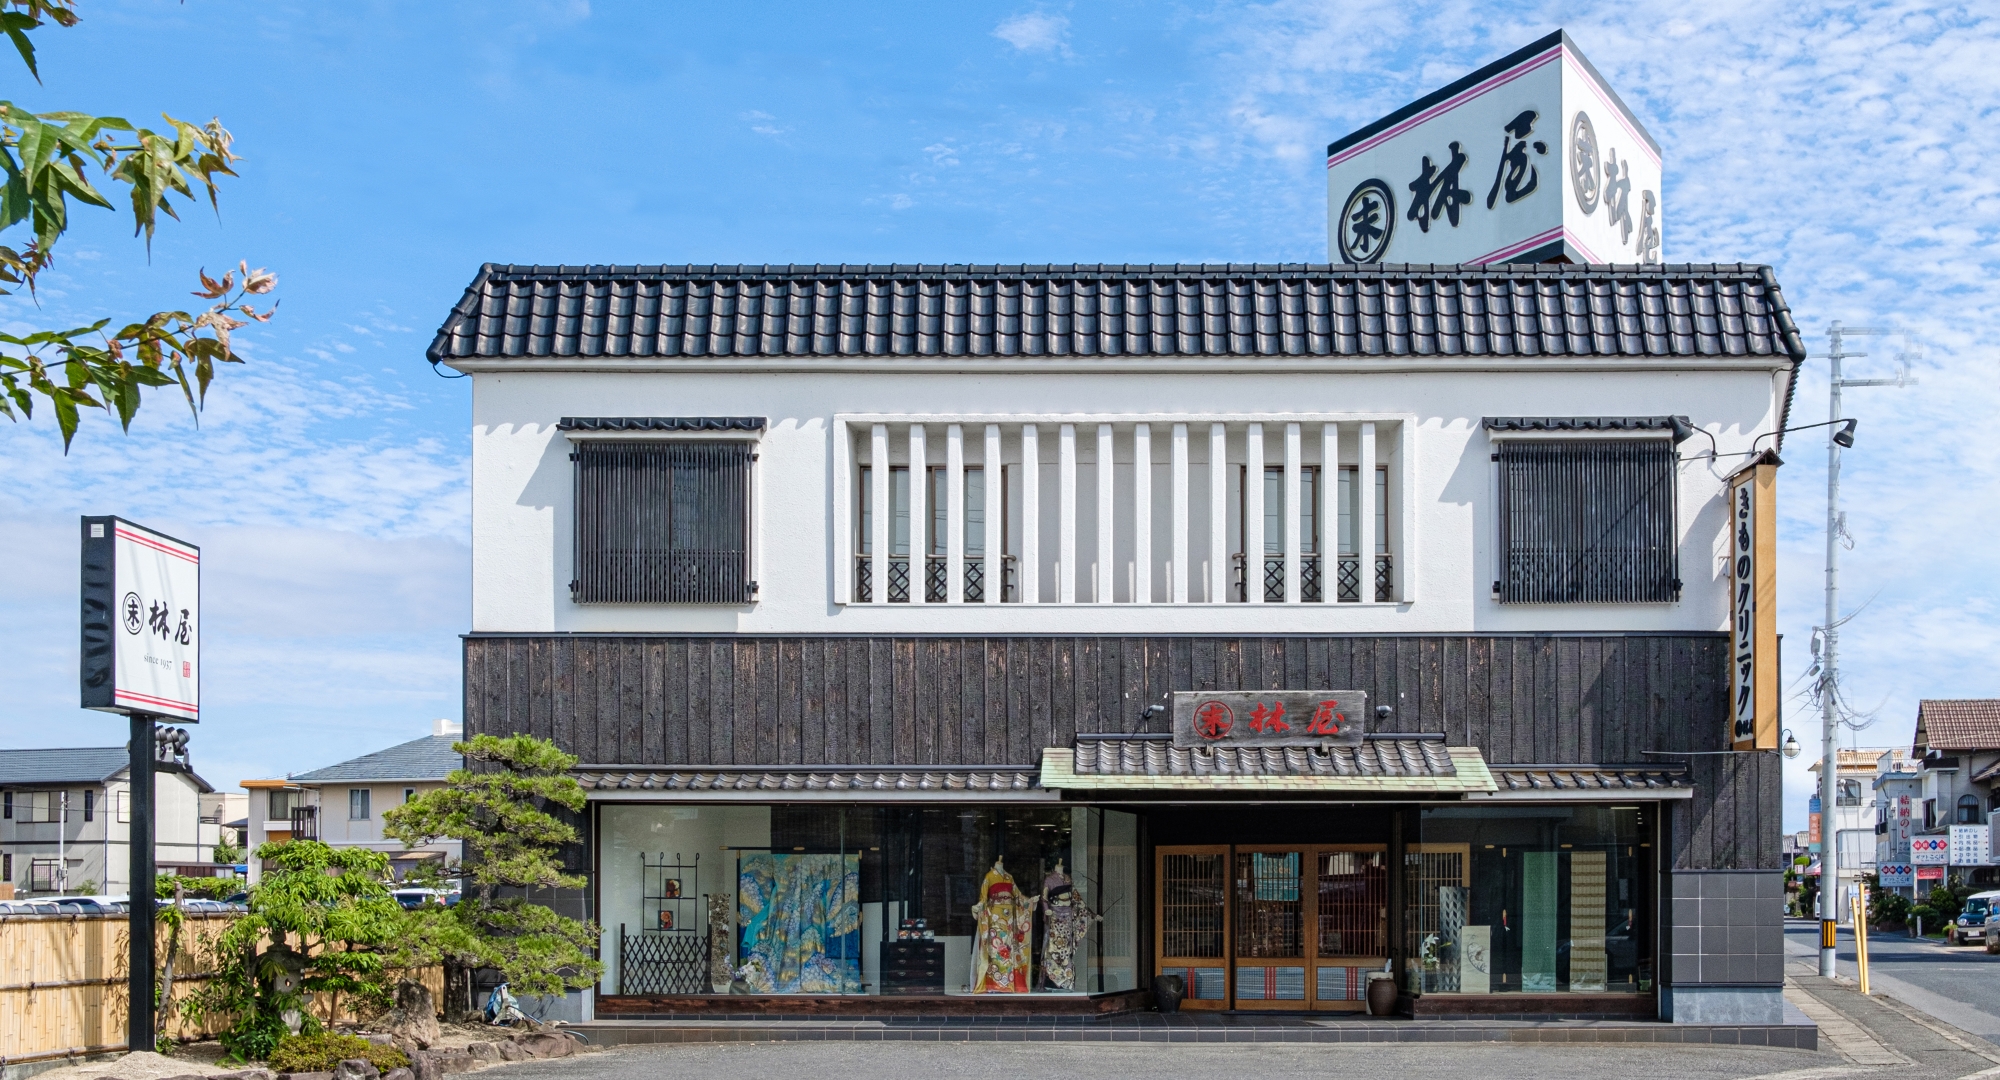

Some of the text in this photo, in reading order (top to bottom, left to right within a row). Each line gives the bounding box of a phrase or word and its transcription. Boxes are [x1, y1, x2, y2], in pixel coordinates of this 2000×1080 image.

[1407, 110, 1548, 233] 林屋
[148, 598, 193, 646] 林屋
[1736, 487, 1751, 717] きものクリニック
[143, 652, 159, 665] since
[160, 658, 172, 671] 1937
[1247, 699, 1346, 735] 林屋
[1899, 795, 1910, 840] 結納のし
